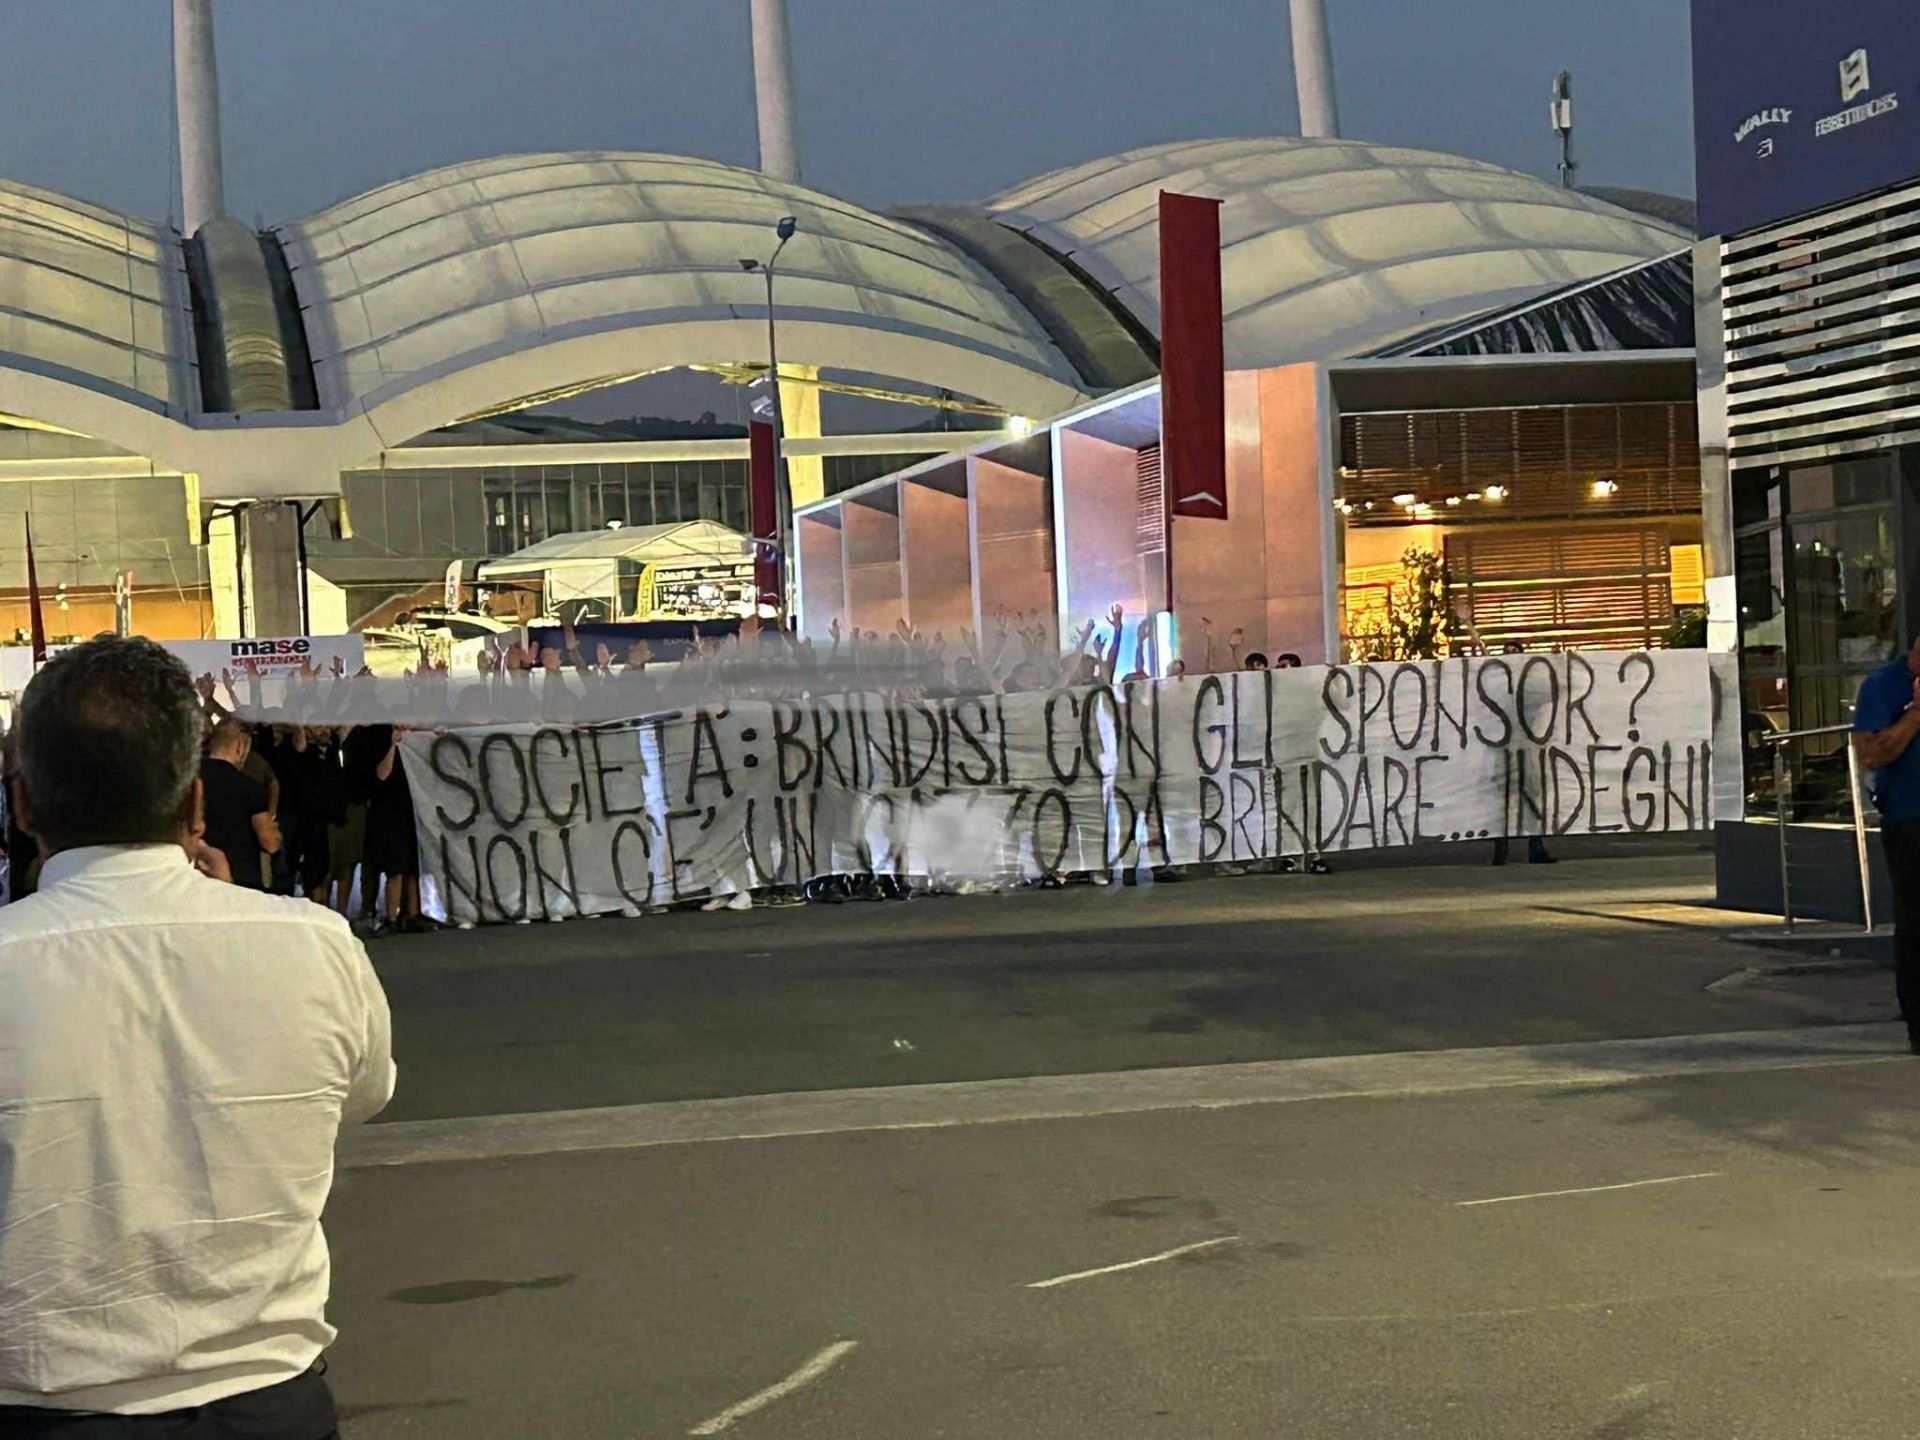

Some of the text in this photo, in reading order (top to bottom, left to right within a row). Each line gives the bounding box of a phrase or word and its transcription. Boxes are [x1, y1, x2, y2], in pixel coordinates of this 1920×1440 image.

[231, 639, 310, 656] mase
[773, 692, 1009, 791] BRINDISI
[1045, 680, 1161, 785] CON
[1193, 668, 1272, 775] GLI
[441, 825, 582, 921] NON
[746, 792, 818, 886] UN
[1103, 782, 1172, 868] DA
[1503, 739, 1711, 838] INDEGNI
